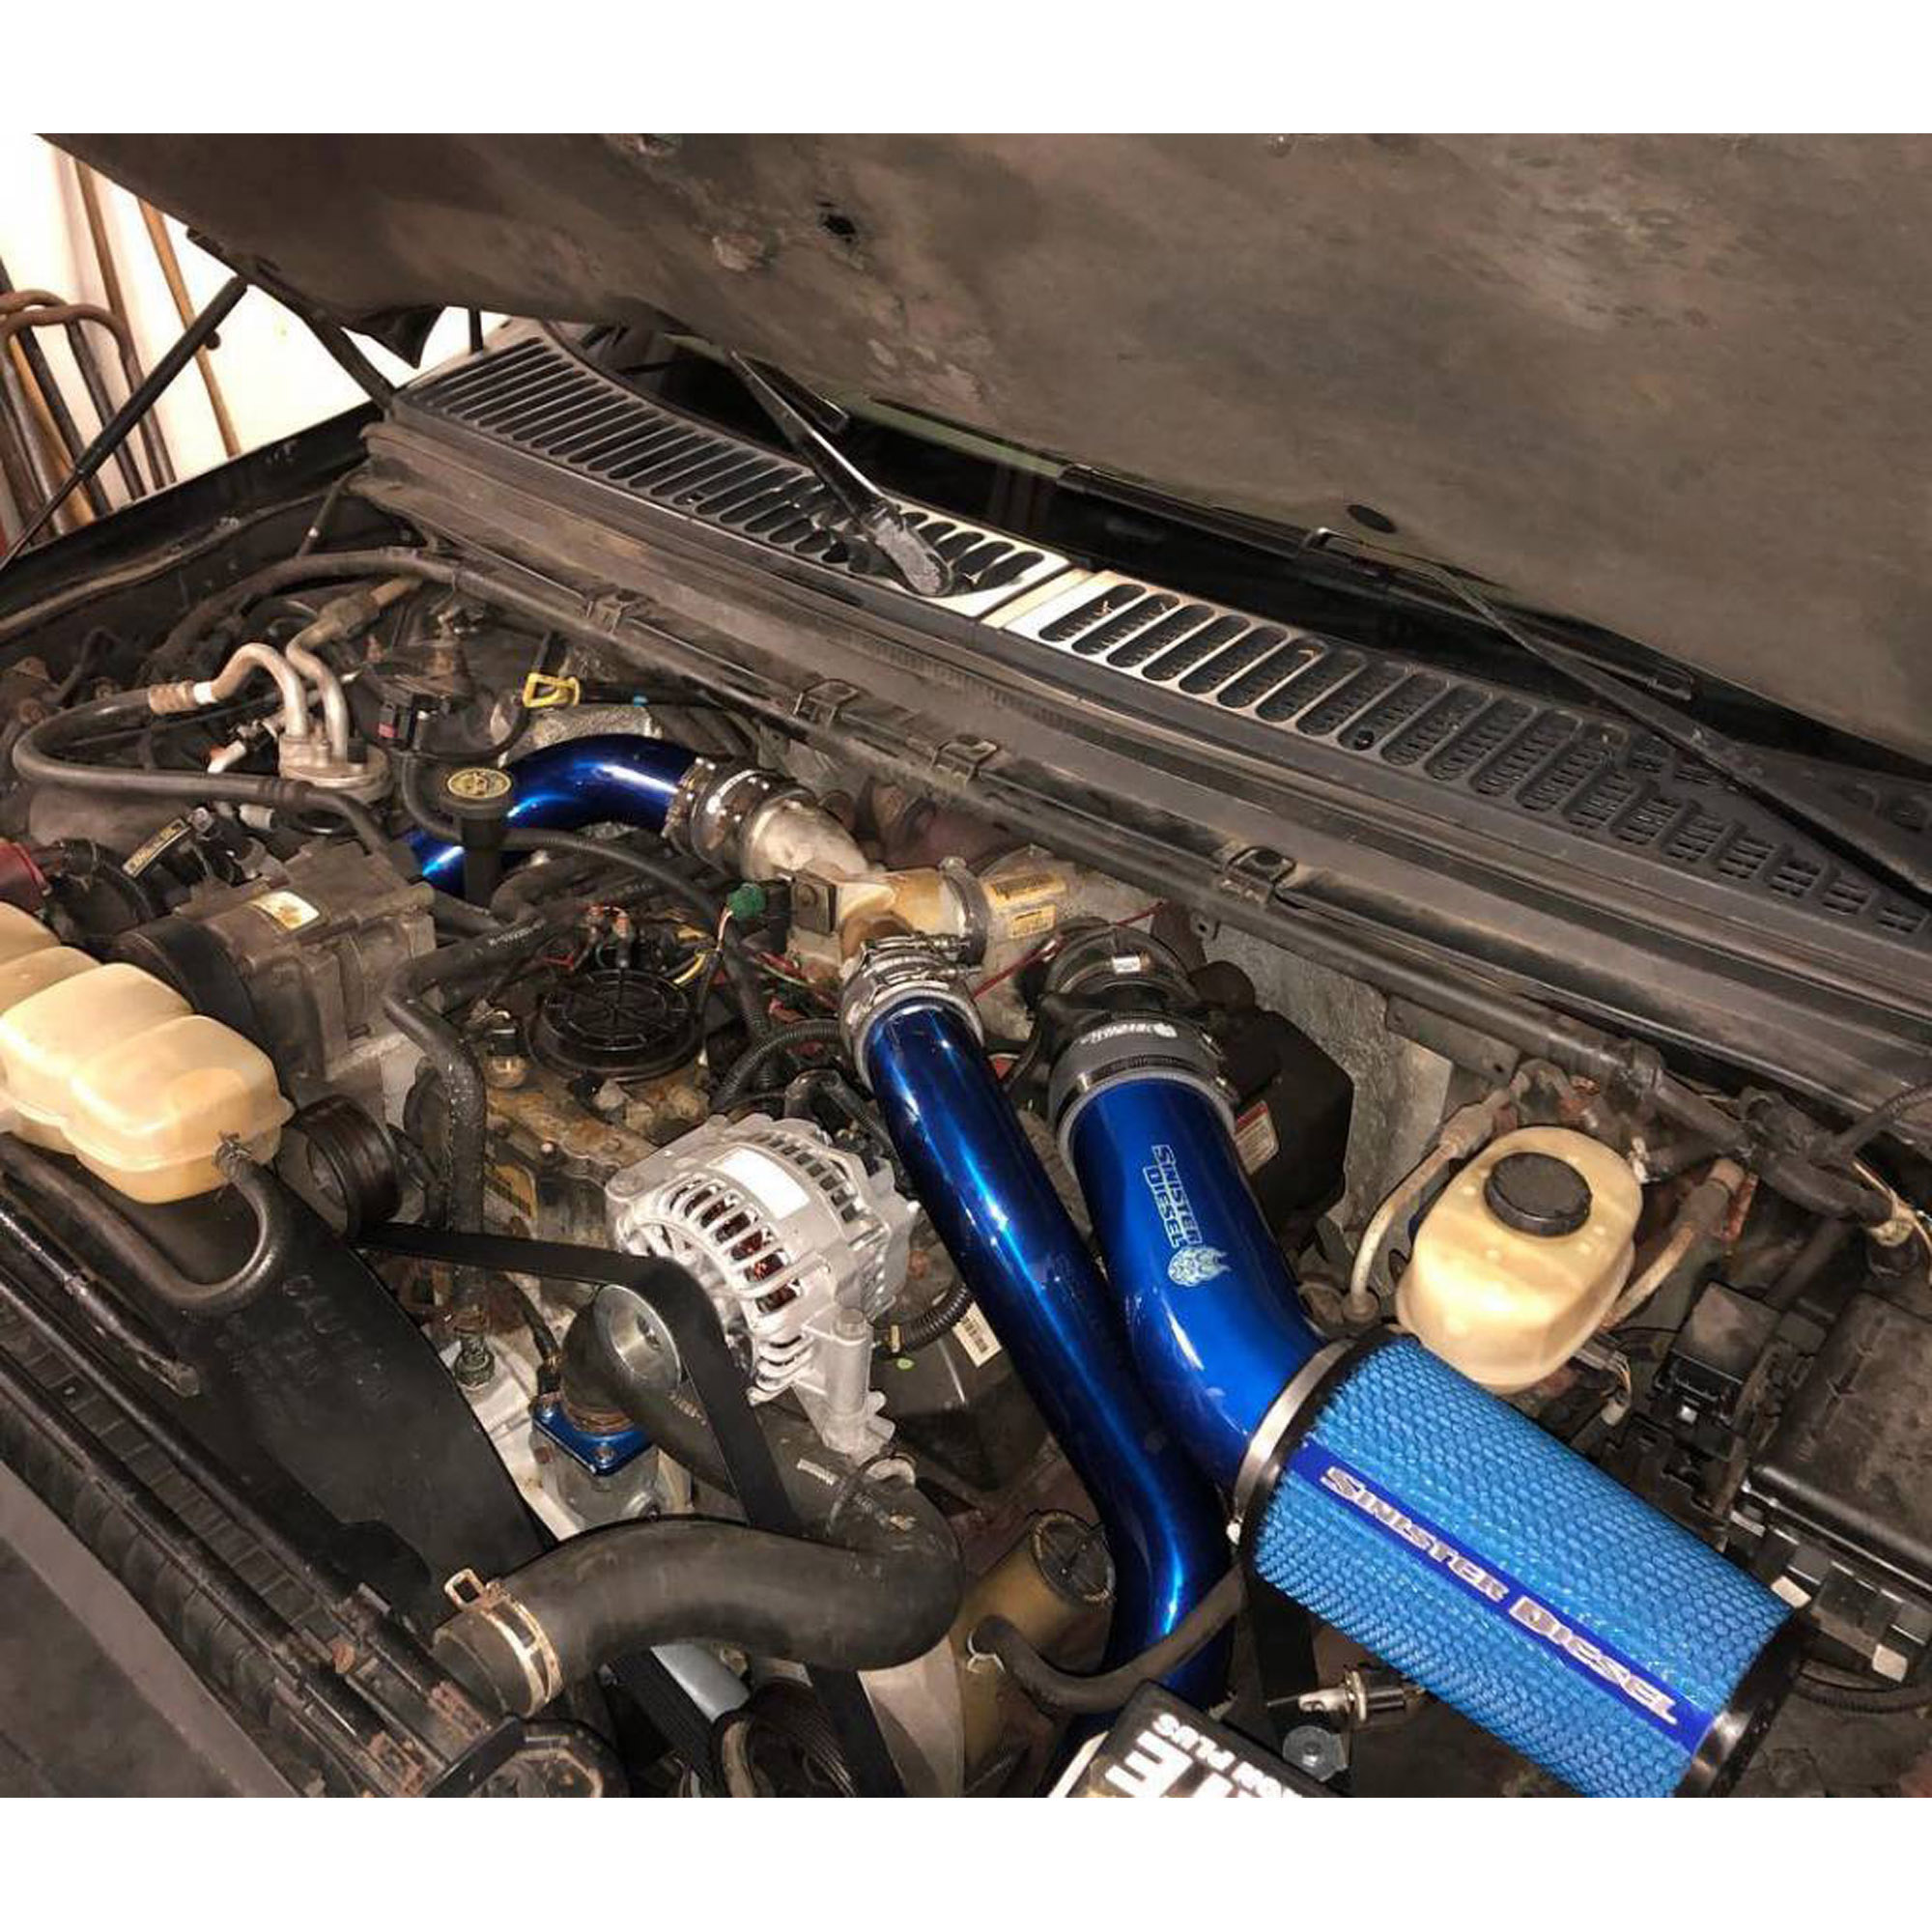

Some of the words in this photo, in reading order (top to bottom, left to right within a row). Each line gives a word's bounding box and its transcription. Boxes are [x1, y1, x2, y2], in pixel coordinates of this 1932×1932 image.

[1143, 1164, 1183, 1249] DIESEL
[1151, 1144, 1204, 1245] SINISTER
[1320, 1465, 1510, 1603] SINISTER
[1509, 1595, 1678, 1726] DIESEL
[1151, 1712, 1236, 1772] PLUS
